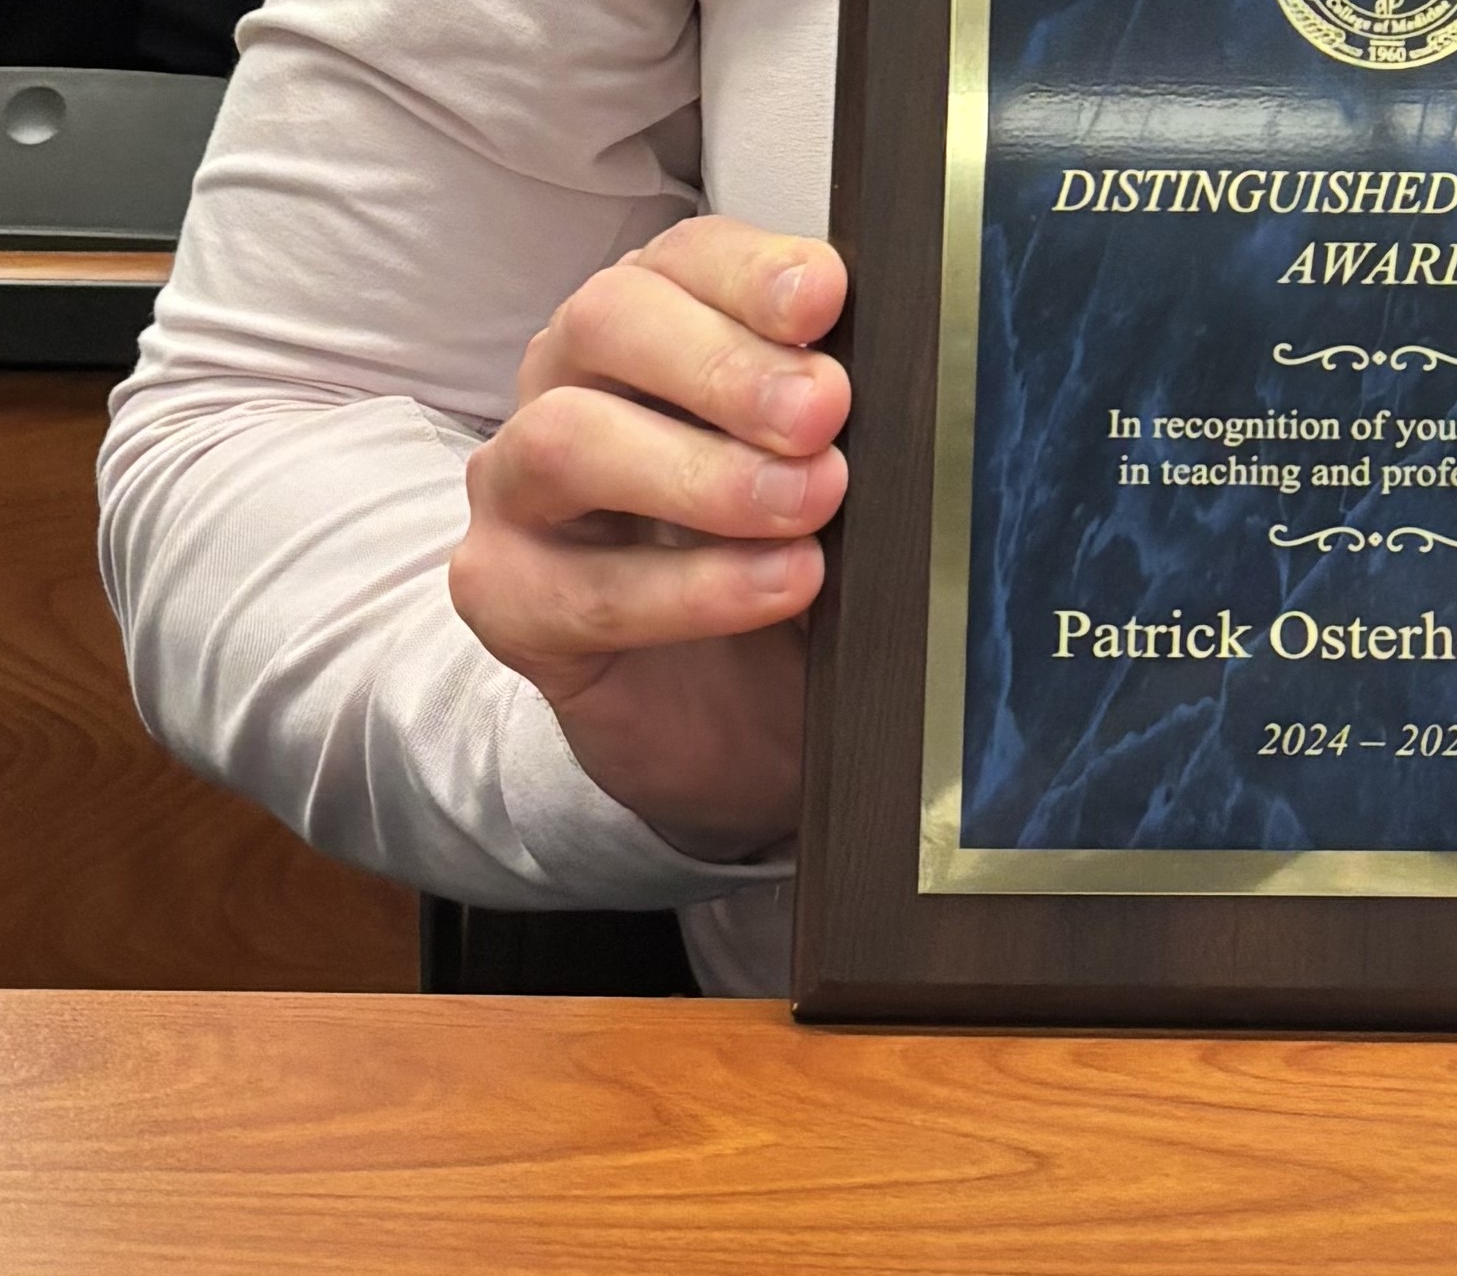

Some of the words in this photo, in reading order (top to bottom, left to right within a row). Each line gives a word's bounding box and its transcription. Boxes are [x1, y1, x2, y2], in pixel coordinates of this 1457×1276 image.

[1367, 45, 1407, 63] 1960
[1108, 408, 1142, 439] In
[1152, 408, 1341, 448] recognition
[1350, 409, 1392, 441] of
[1118, 453, 1151, 486] in
[1160, 454, 1302, 495] teaching
[1310, 455, 1372, 487] and
[1051, 608, 1253, 660] Patrick
[1257, 722, 1352, 757] 2024
